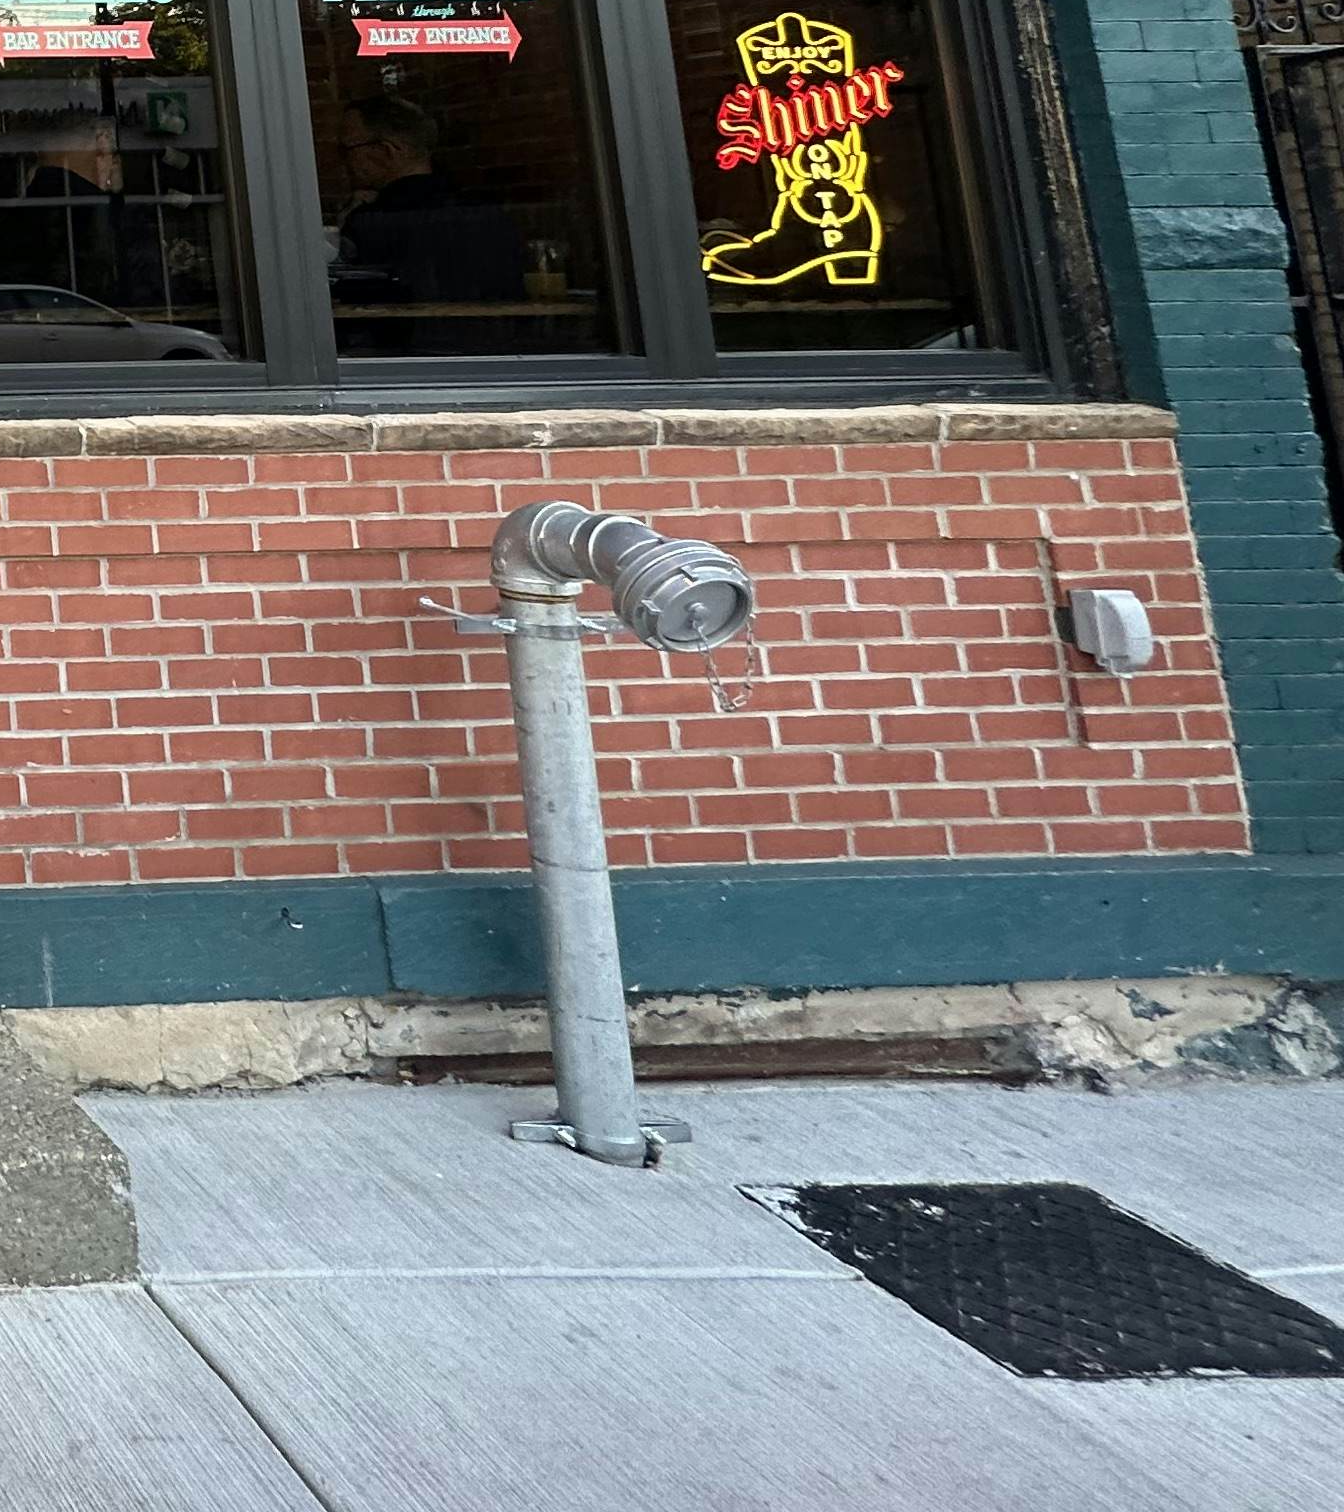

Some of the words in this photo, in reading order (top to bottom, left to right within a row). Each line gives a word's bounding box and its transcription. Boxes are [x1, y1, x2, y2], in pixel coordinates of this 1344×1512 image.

[3, 31, 40, 50] BAR
[46, 29, 141, 49] ENTRANCE
[367, 27, 421, 46] ALLEY
[424, 26, 512, 45] ENTRANCE
[761, 46, 832, 60] ENJOY
[715, 61, 904, 171] Shiner
[807, 143, 832, 180] ON
[815, 190, 844, 248] TAP
